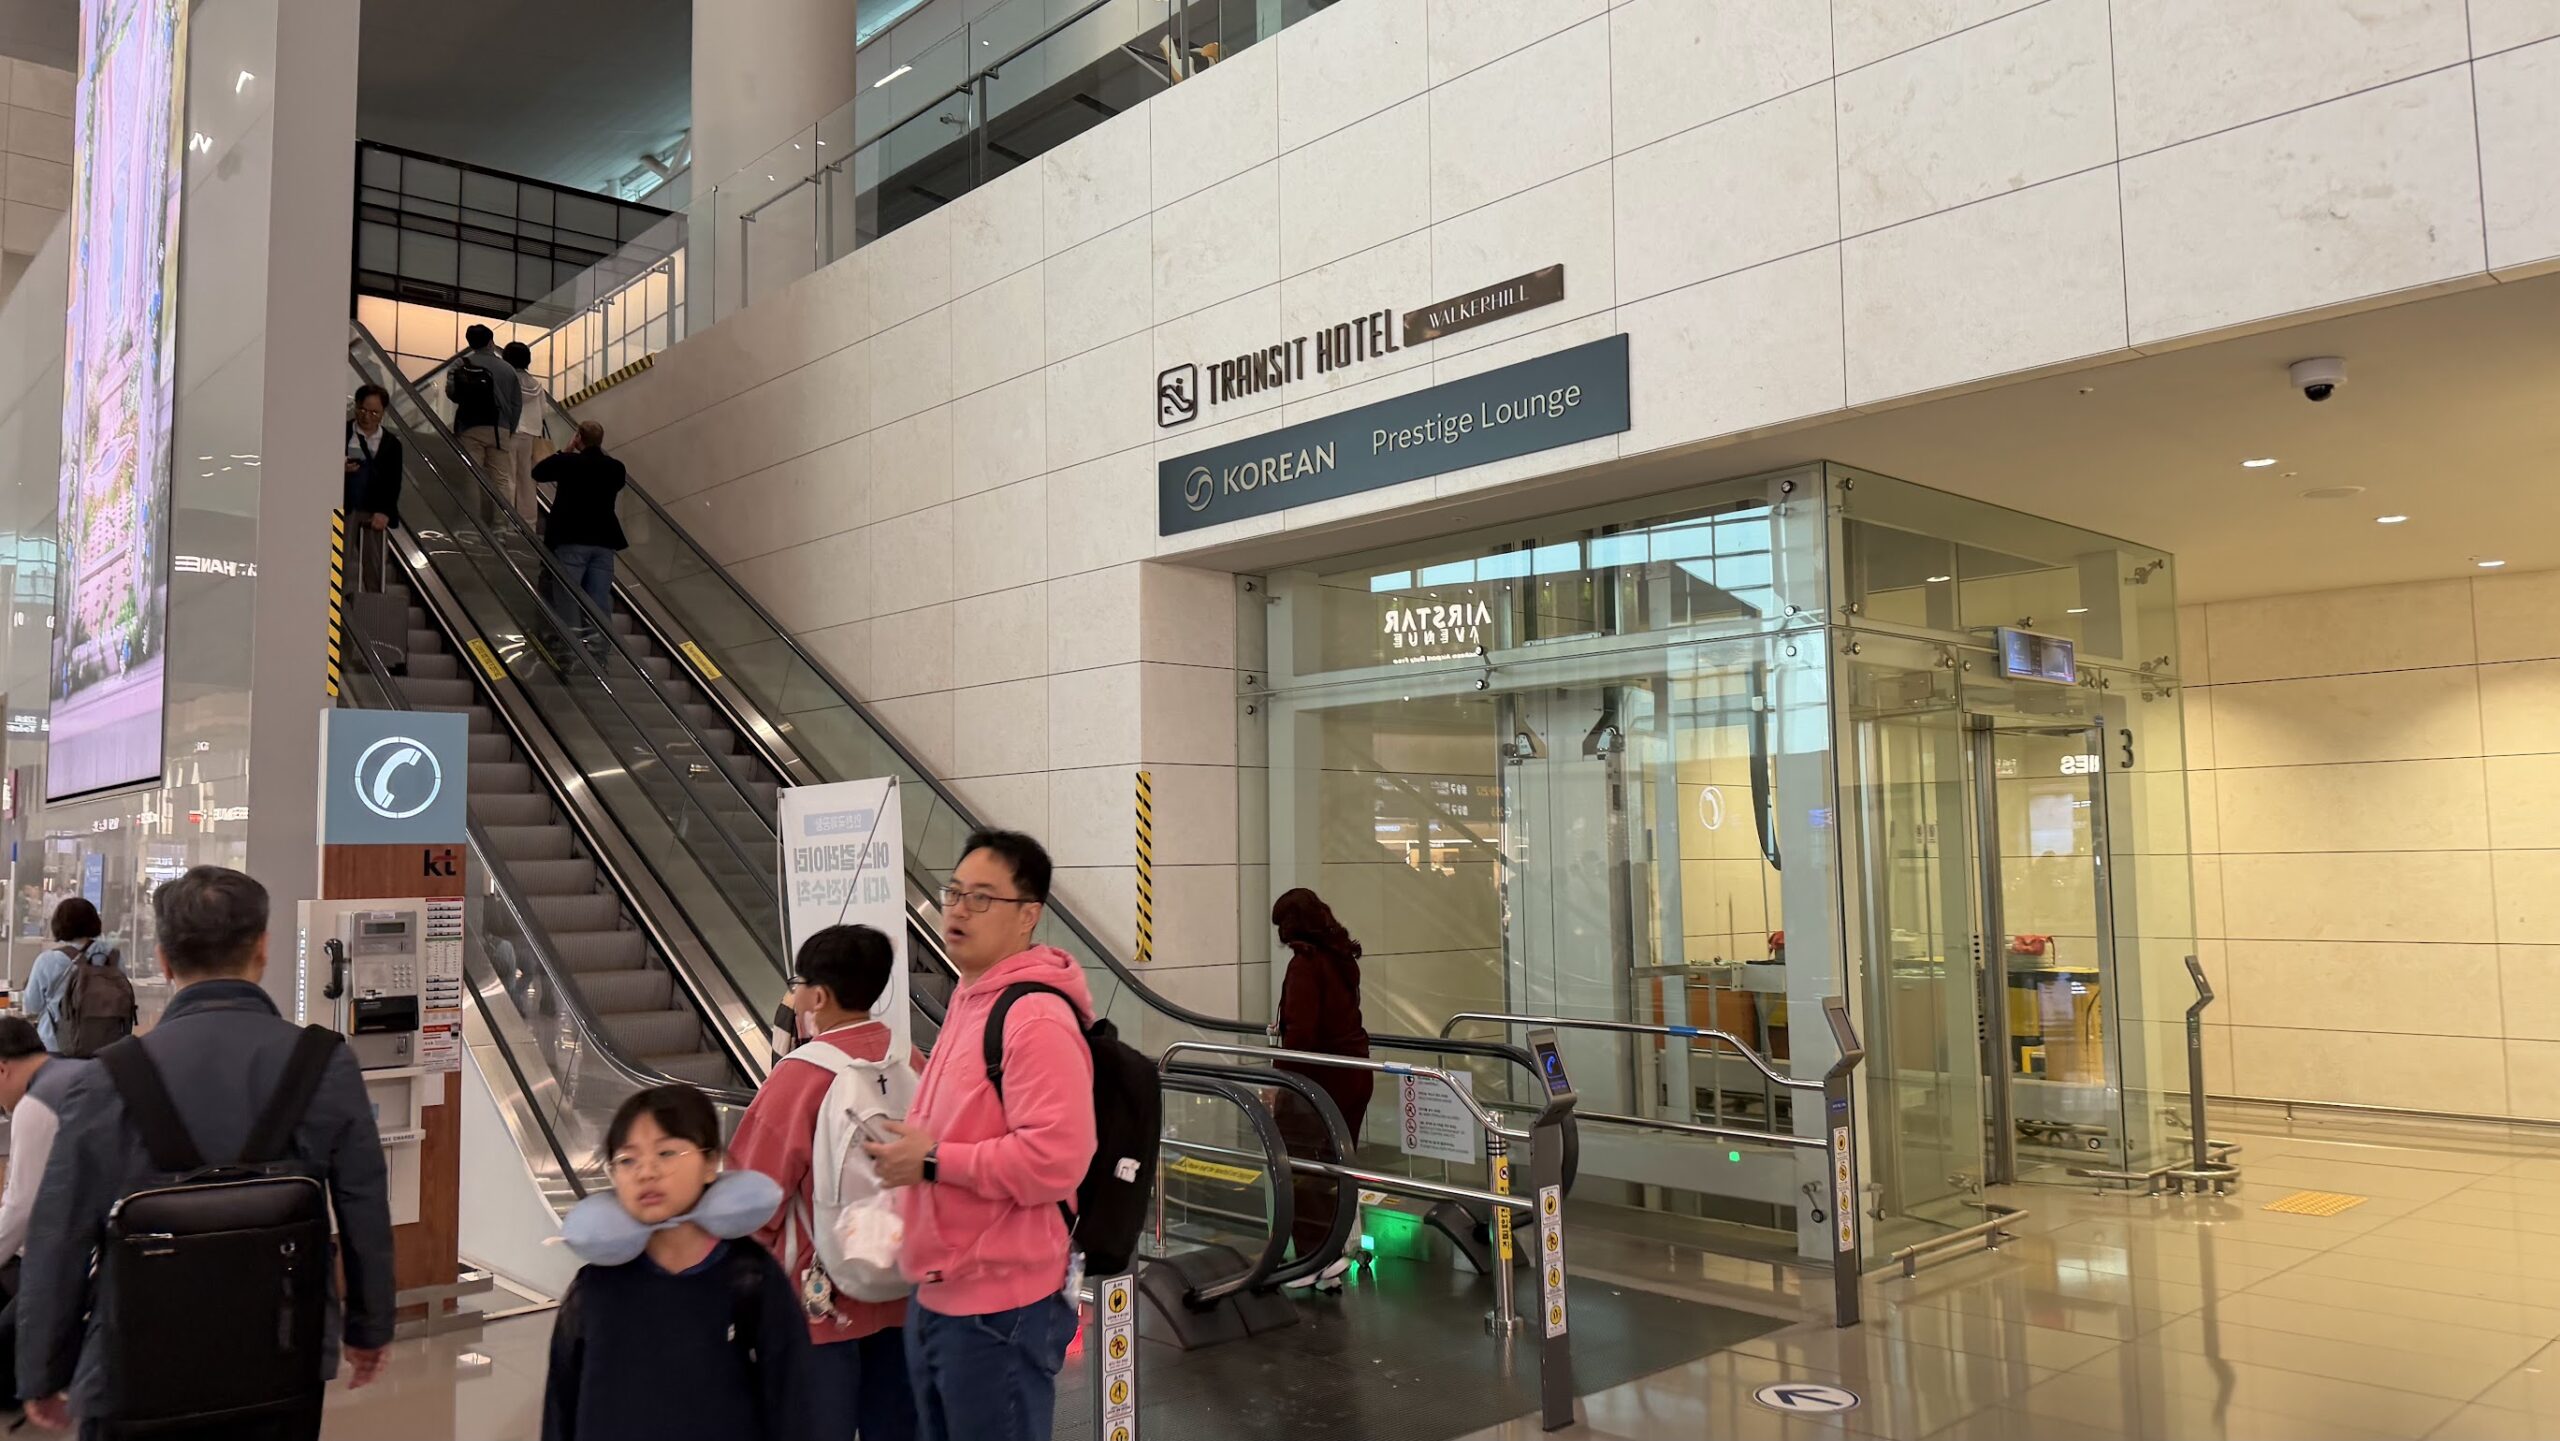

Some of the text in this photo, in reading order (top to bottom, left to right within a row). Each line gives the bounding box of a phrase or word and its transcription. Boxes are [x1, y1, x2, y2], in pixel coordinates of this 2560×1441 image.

[1428, 284, 1530, 330] WALKERHILL
[1206, 308, 1400, 406] TRANSIT HOTEL
[1223, 383, 1582, 496] KOREAN Prestige Lounge
[2119, 728, 2135, 769] 3
[423, 849, 457, 878] kt
